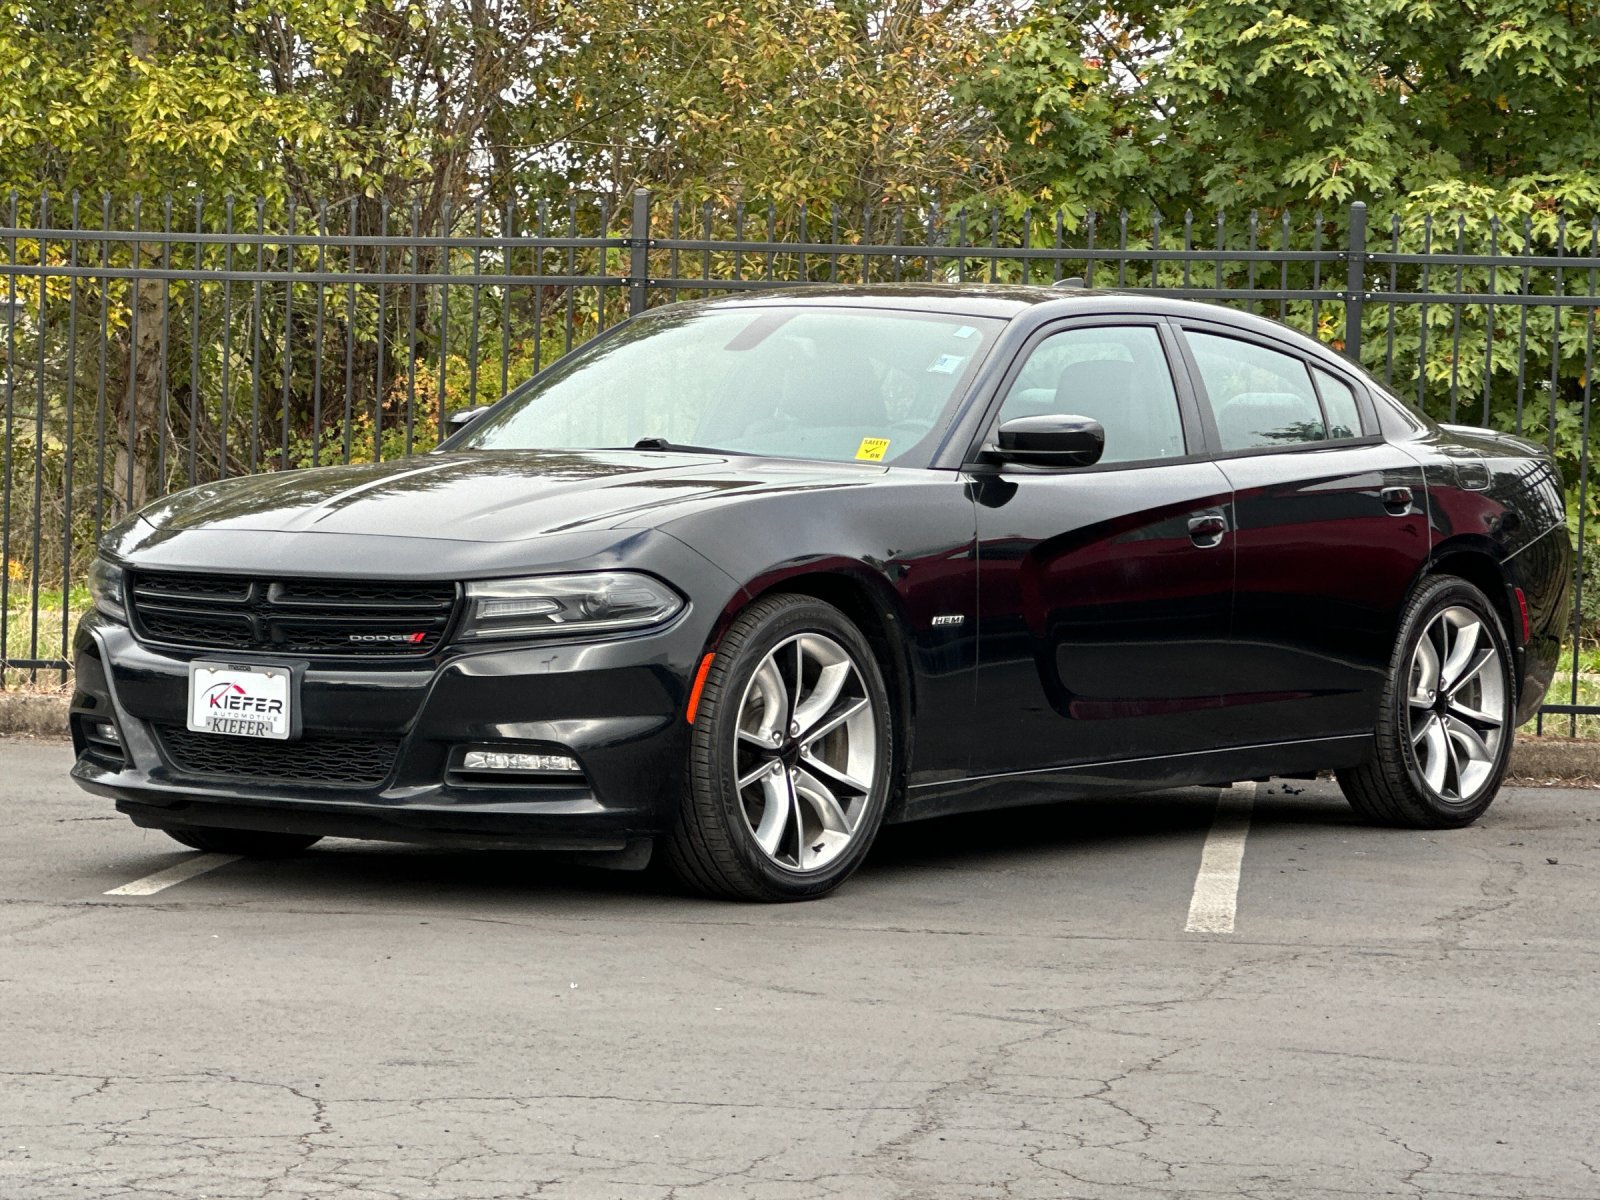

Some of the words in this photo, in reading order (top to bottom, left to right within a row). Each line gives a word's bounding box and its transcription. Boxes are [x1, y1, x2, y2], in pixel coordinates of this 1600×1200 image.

[932, 615, 965, 625] HEMI
[209, 691, 283, 714] KIEFER
[213, 711, 278, 722] AUTOMOTIVE
[212, 718, 266, 736] KIEFER
